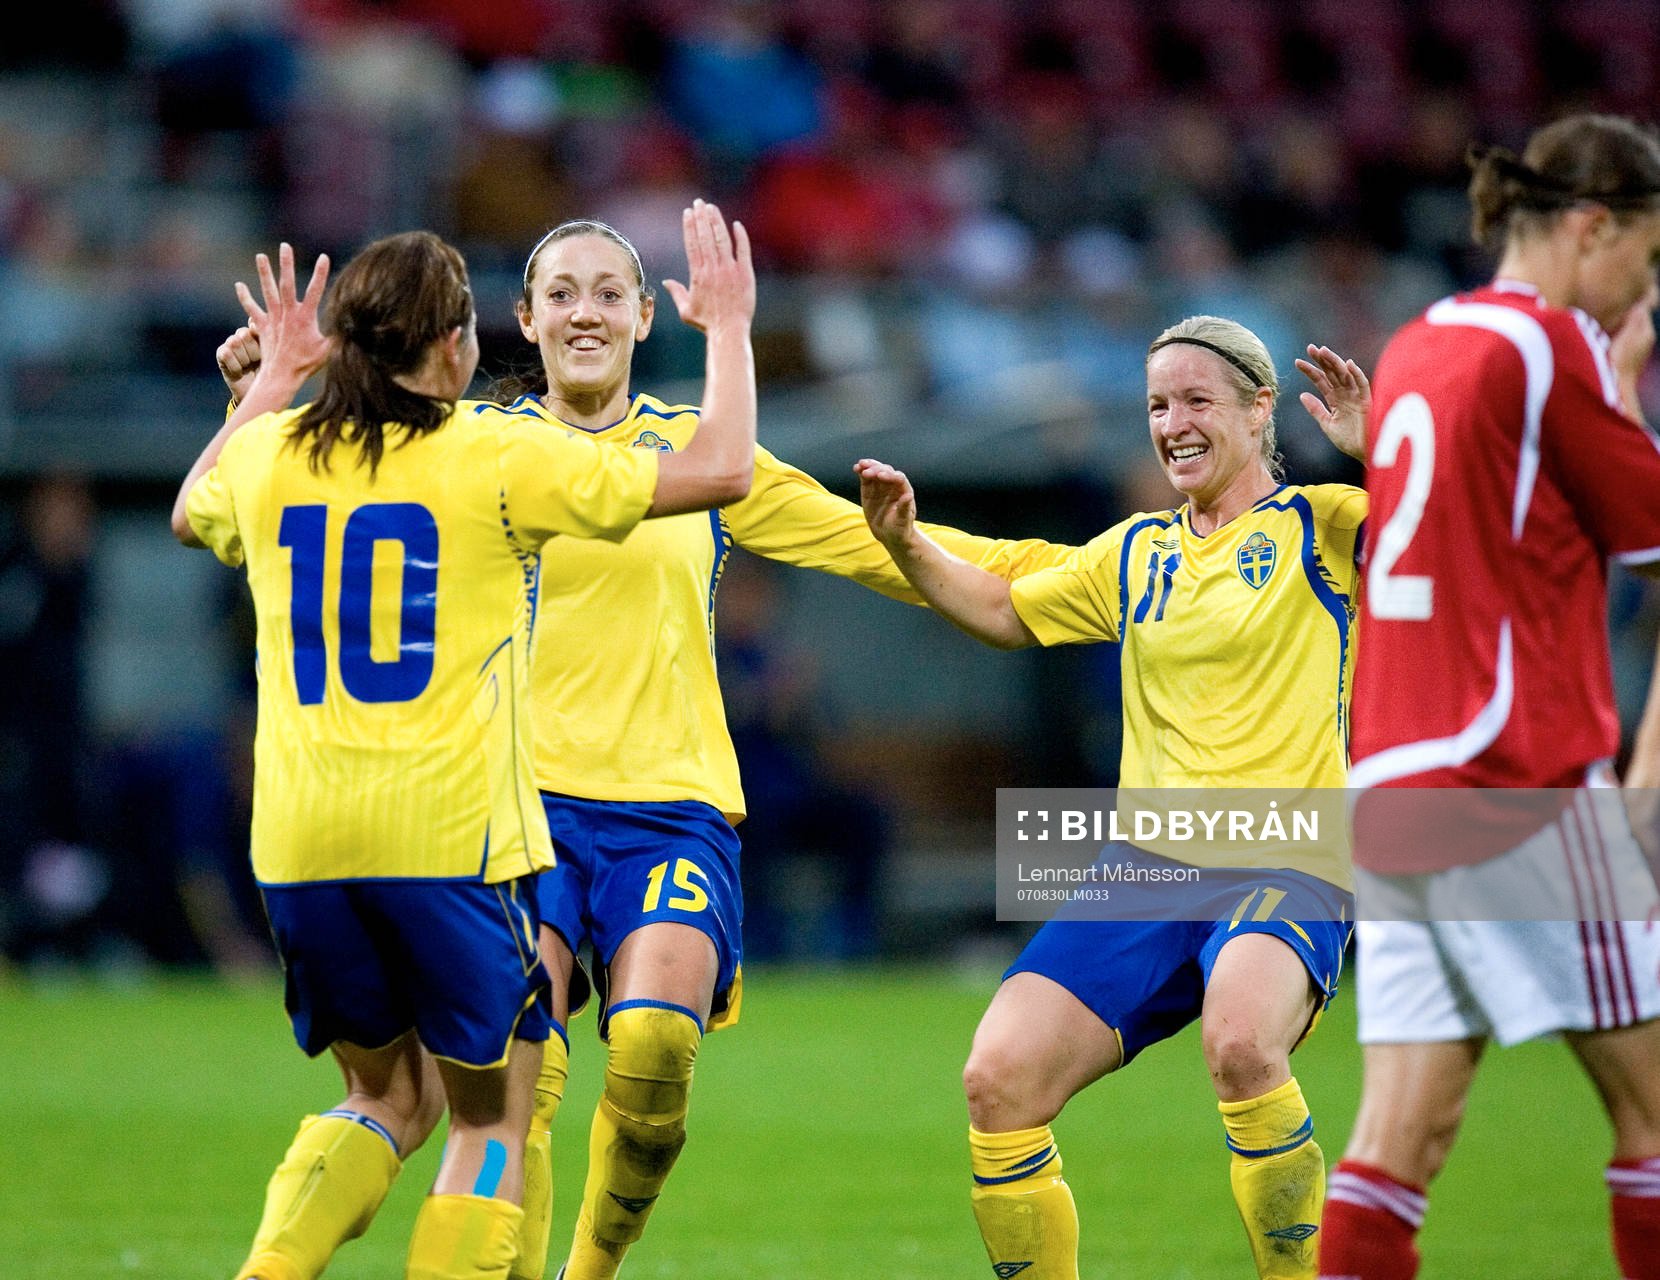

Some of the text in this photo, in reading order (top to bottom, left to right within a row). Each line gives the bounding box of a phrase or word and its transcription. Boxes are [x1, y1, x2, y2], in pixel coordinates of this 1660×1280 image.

[1368, 391, 1436, 621] 2
[278, 502, 439, 706] 10
[1133, 551, 1182, 624] 11
[642, 857, 709, 913] 15
